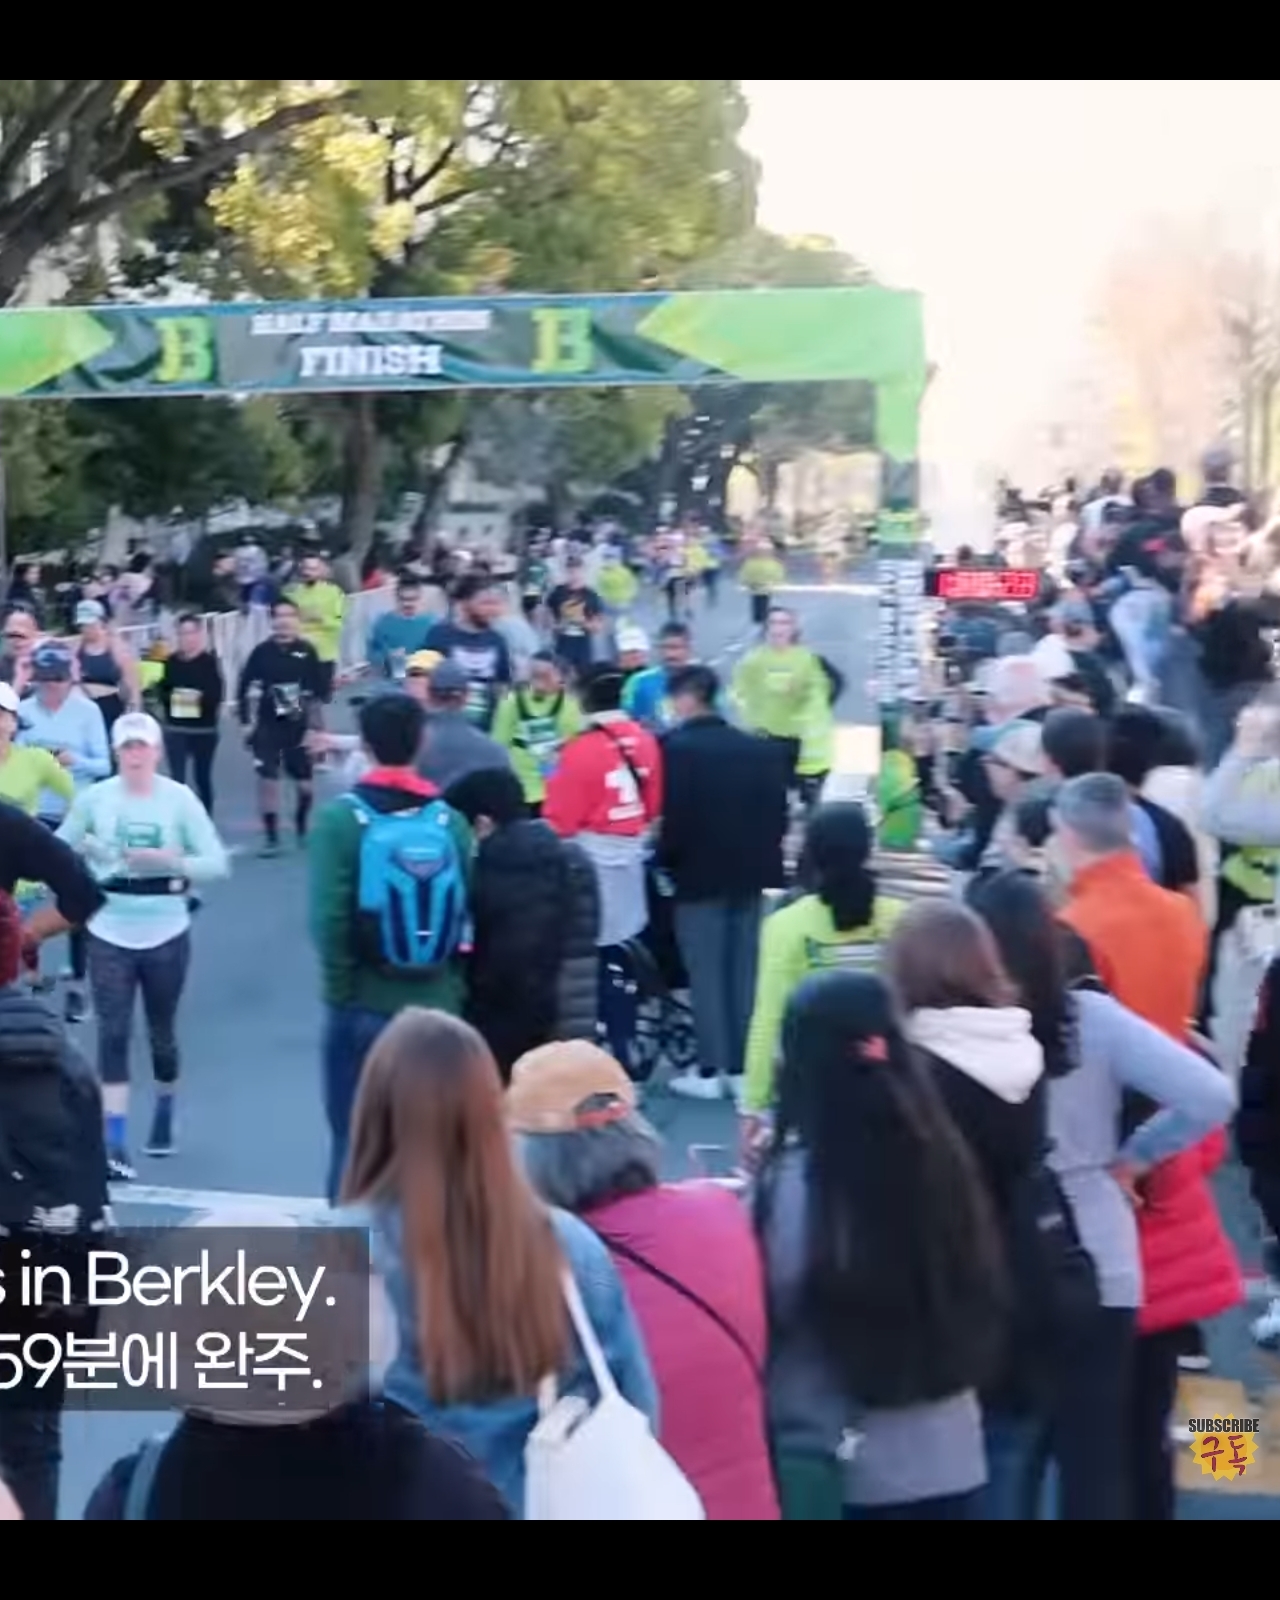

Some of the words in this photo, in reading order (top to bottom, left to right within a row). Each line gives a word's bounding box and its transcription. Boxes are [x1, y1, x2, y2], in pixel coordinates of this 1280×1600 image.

[155, 315, 212, 382] B
[299, 344, 444, 378] FINISH
[531, 307, 594, 374] B
